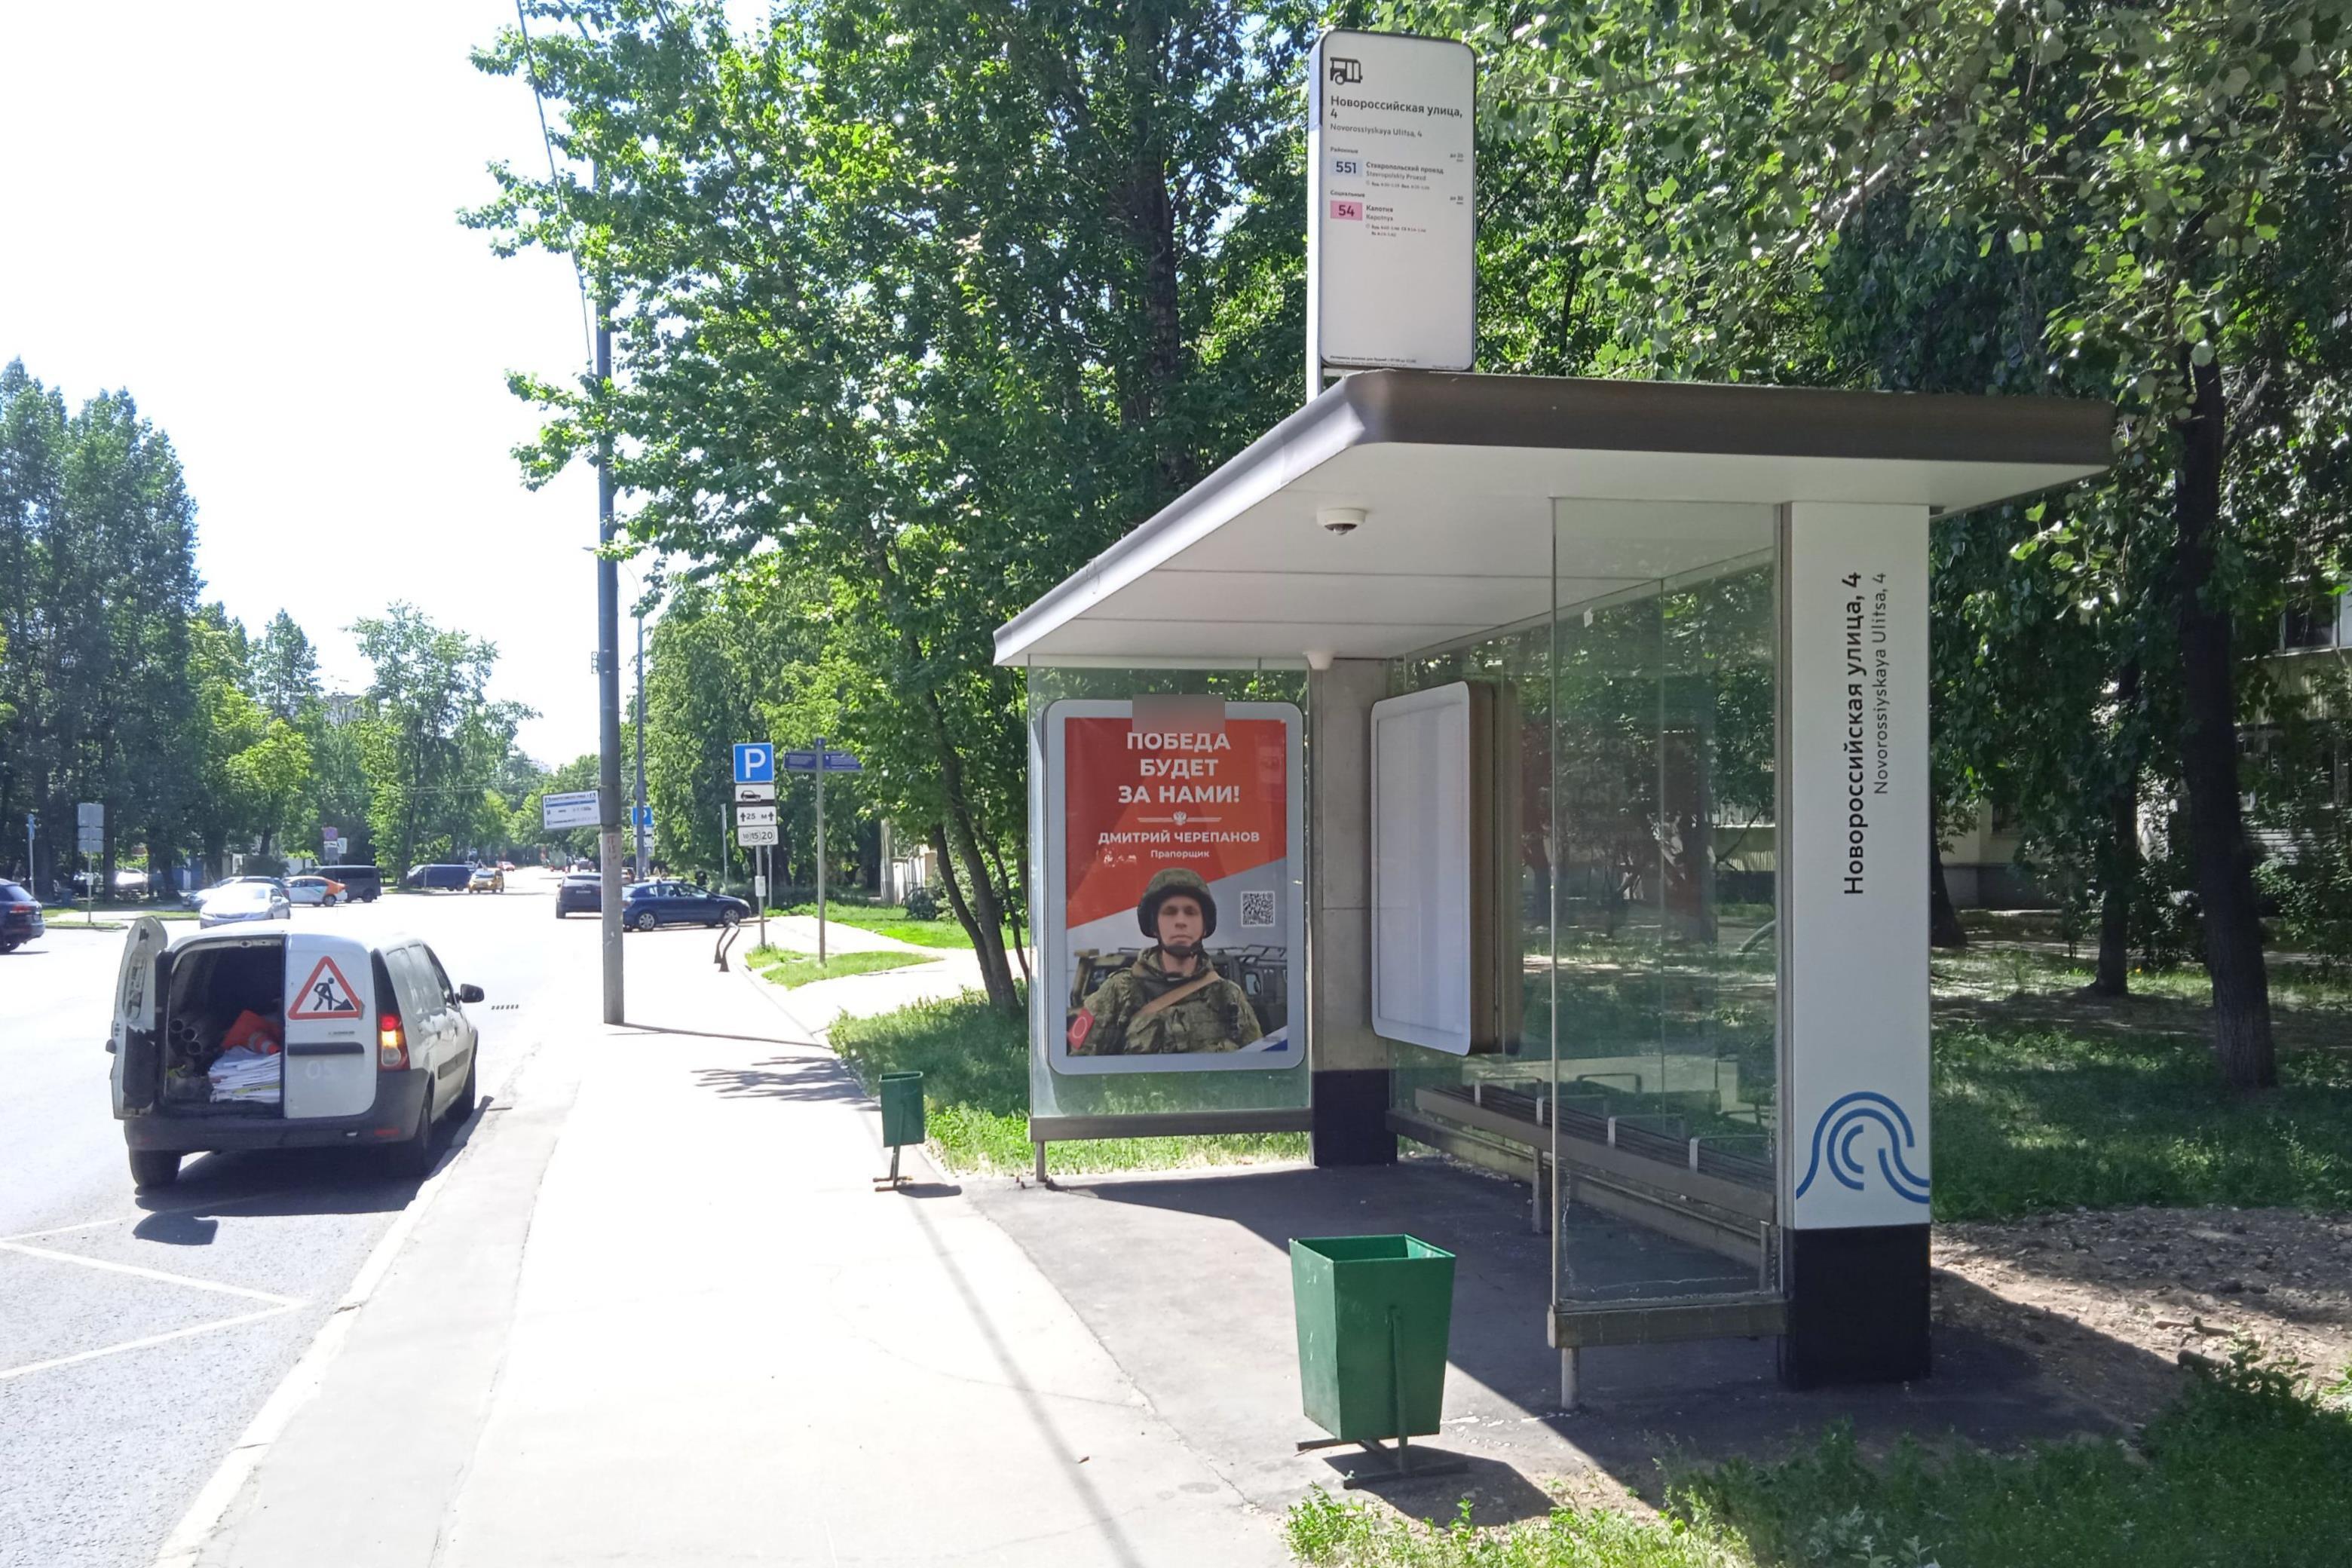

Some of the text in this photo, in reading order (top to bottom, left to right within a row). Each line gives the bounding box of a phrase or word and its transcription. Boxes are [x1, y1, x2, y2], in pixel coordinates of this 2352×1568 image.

[1331, 95, 1462, 118] Новороссийская улица,
[1331, 108, 1337, 118] 4
[1331, 123, 1392, 136] Novorossiyskaya
[1336, 161, 1356, 174] 551
[1365, 161, 1444, 174] Ставропольский проезд
[1338, 204, 1355, 217] 54
[1871, 573, 1890, 794] Novorossiyskaya Ulitsa, 4
[1842, 571, 1868, 894] Новороссийская улица, 4
[1127, 732, 1231, 752] ПОБЕДА
[745, 749, 766, 779] P
[1140, 758, 1218, 779] БУДЕТ
[1118, 785, 1240, 804] ЗА НАМИ!
[761, 831, 773, 840] 20
[1098, 829, 1260, 845] ДМИТРИЙ ЧЕРЕПАНОВ
[1150, 850, 1210, 859] Прапорщик
